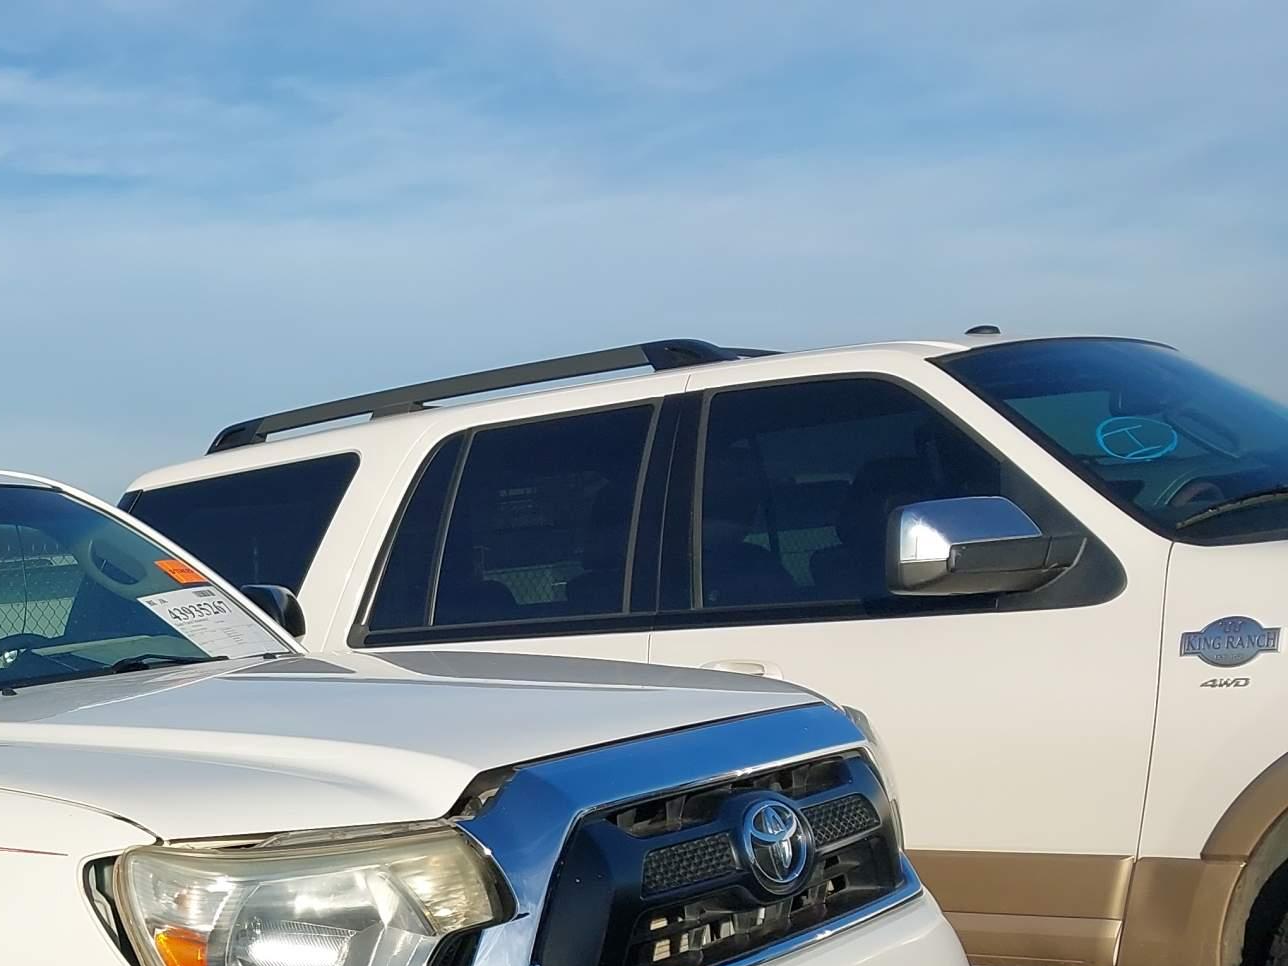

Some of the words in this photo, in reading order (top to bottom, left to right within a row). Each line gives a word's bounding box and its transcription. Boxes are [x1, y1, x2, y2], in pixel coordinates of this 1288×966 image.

[167, 600, 232, 621] 43935267
[1185, 633, 1221, 651] KING
[1224, 631, 1277, 650] RANCH
[1199, 677, 1250, 688] 4WD
